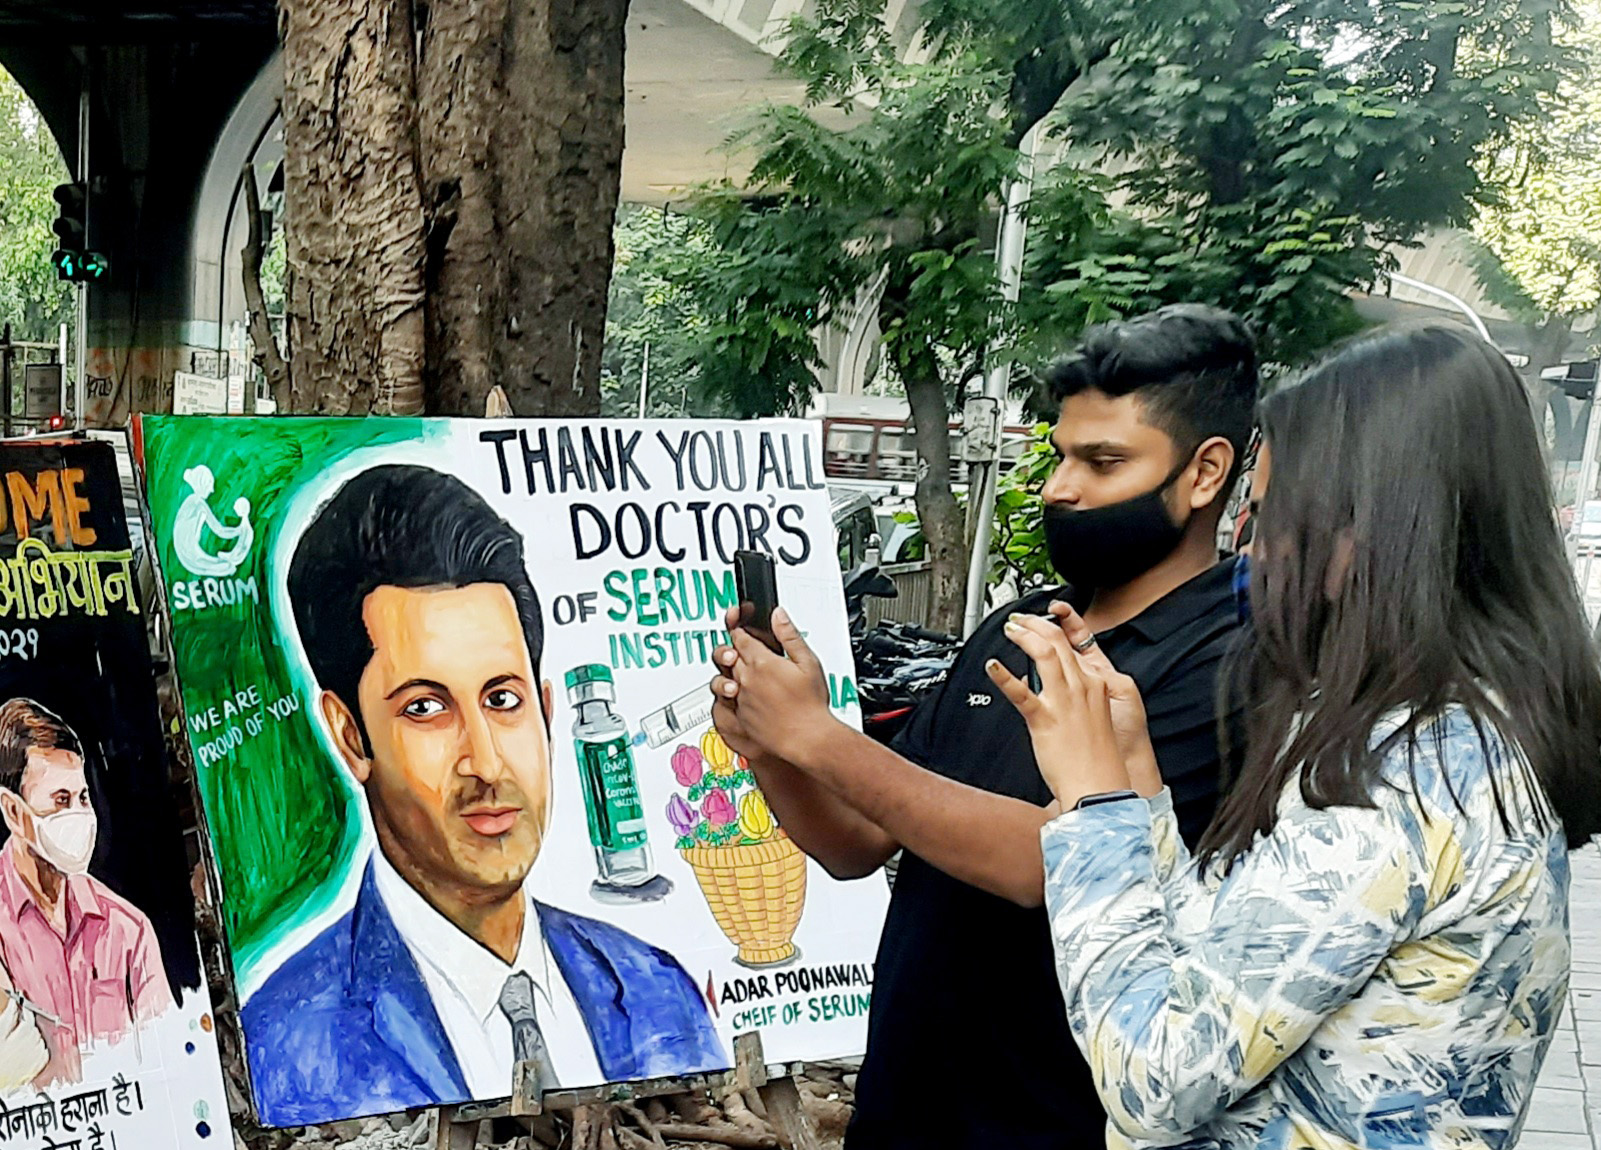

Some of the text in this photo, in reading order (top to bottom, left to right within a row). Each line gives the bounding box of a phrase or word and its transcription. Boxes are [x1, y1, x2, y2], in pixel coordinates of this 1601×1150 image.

[479, 426, 825, 495] THANK YOU ALL
[569, 494, 811, 566] DOCTOR'S
[172, 576, 259, 611] SERUM
[553, 567, 738, 626] OF SERUM
[190, 685, 262, 733] WE ARE
[198, 692, 300, 768] PROUD OF YOU
[720, 975, 773, 1005] ADAR
[733, 993, 871, 1030] CHEIF OF SERUM
[61, 1088, 109, 1132] हराना
